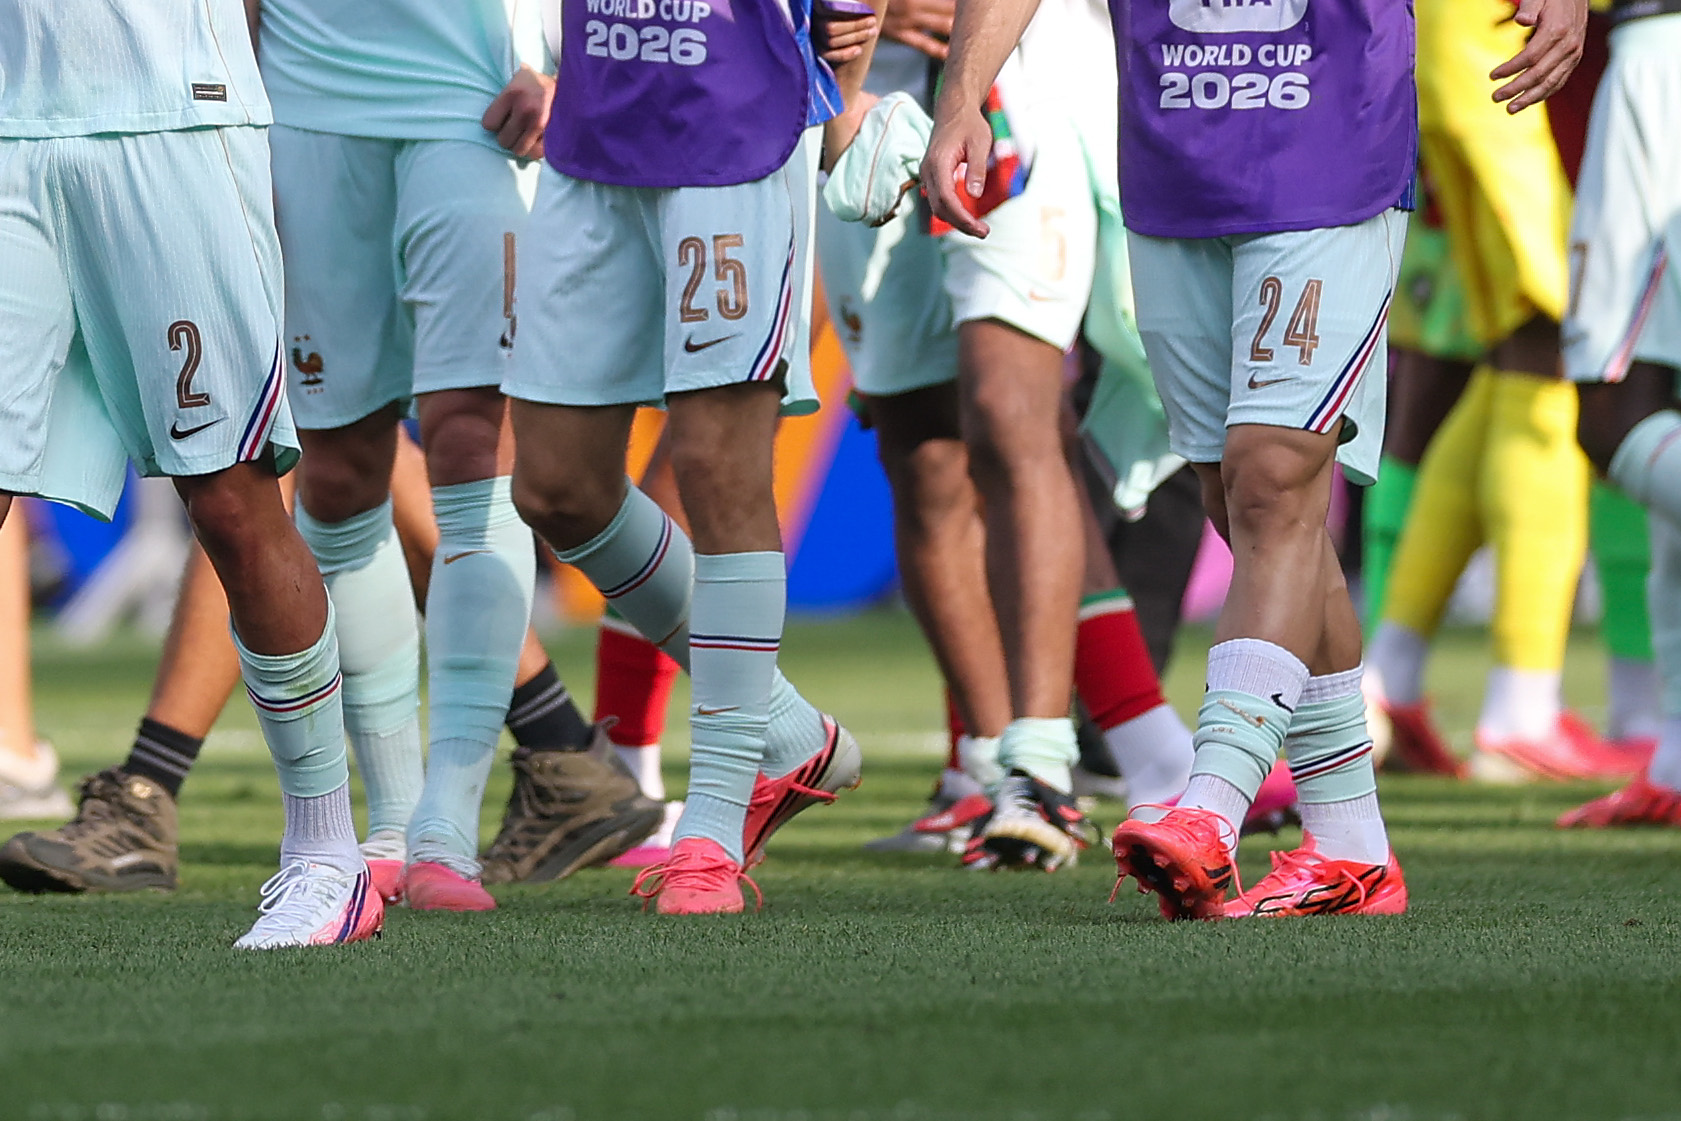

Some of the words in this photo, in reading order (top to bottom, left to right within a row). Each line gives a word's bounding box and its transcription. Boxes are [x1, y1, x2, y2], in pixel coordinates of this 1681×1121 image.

[585, 19, 708, 66] 2026
[1161, 43, 1252, 68] WORLD
[1257, 43, 1313, 68] CUP
[1158, 71, 1311, 110] 2026
[678, 233, 748, 323] 25
[1249, 276, 1323, 367] 24
[167, 320, 211, 409] 2
